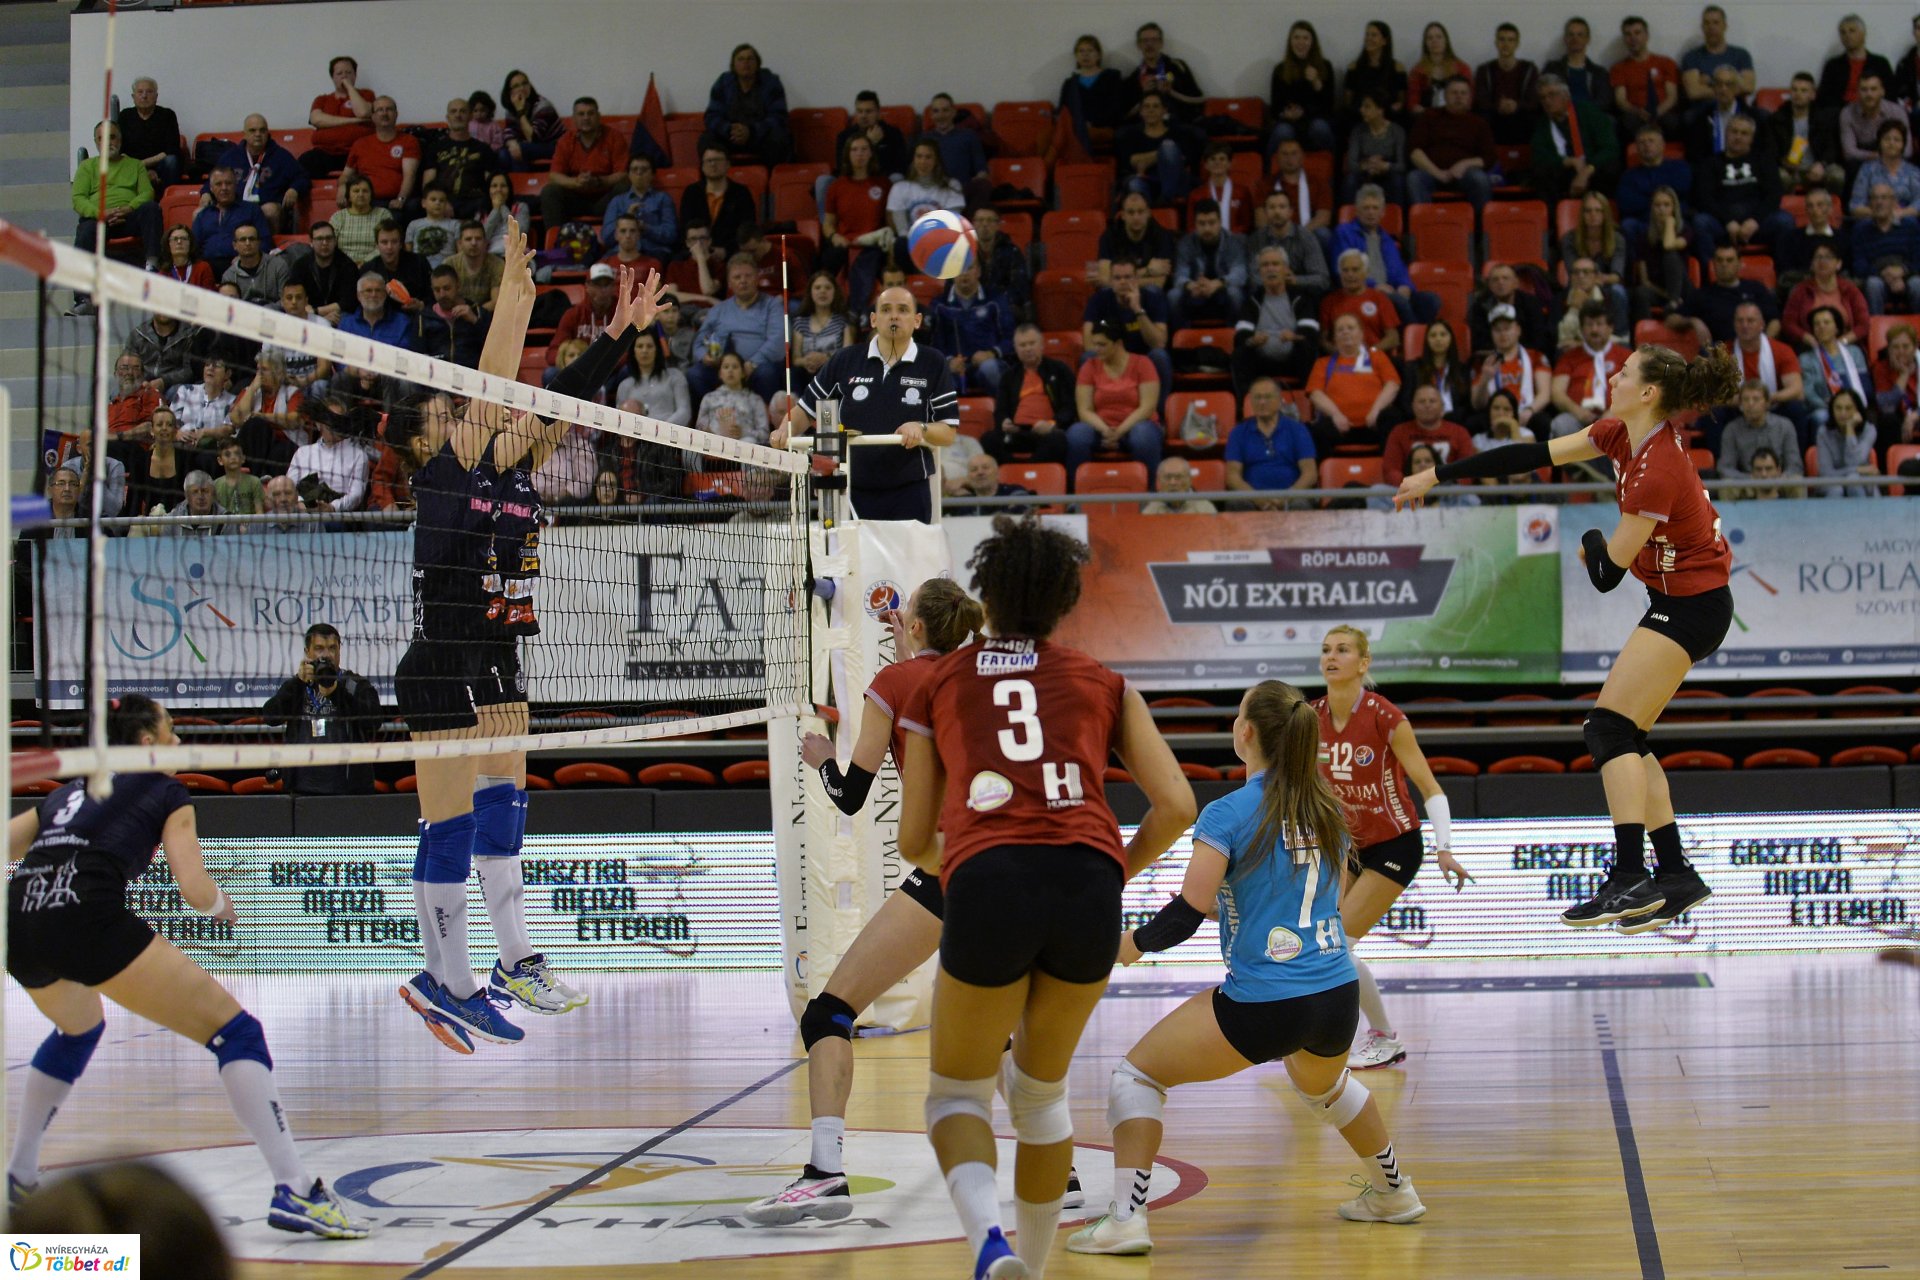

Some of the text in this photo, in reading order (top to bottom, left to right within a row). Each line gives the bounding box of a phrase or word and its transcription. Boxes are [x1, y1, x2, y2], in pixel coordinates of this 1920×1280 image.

[1301, 551, 1390, 567] RÖPLABDA
[314, 573, 383, 588] MAGYAR
[1183, 578, 1418, 608] NŐI EXTRALIGA
[253, 589, 416, 626] RÖPLABD
[1650, 612, 1669, 622] JAKO
[981, 654, 1034, 666] FATUM
[189, 683, 222, 694] hunvolley
[993, 679, 1044, 761] 3
[1331, 742, 1353, 771] 12
[1334, 783, 1379, 798] ATUM
[1514, 843, 1617, 869] GASZTR
[553, 888, 636, 912] MENZA
[1293, 848, 1321, 928] 7
[304, 889, 385, 913] MENZA
[434, 906, 449, 939] MIKASA
